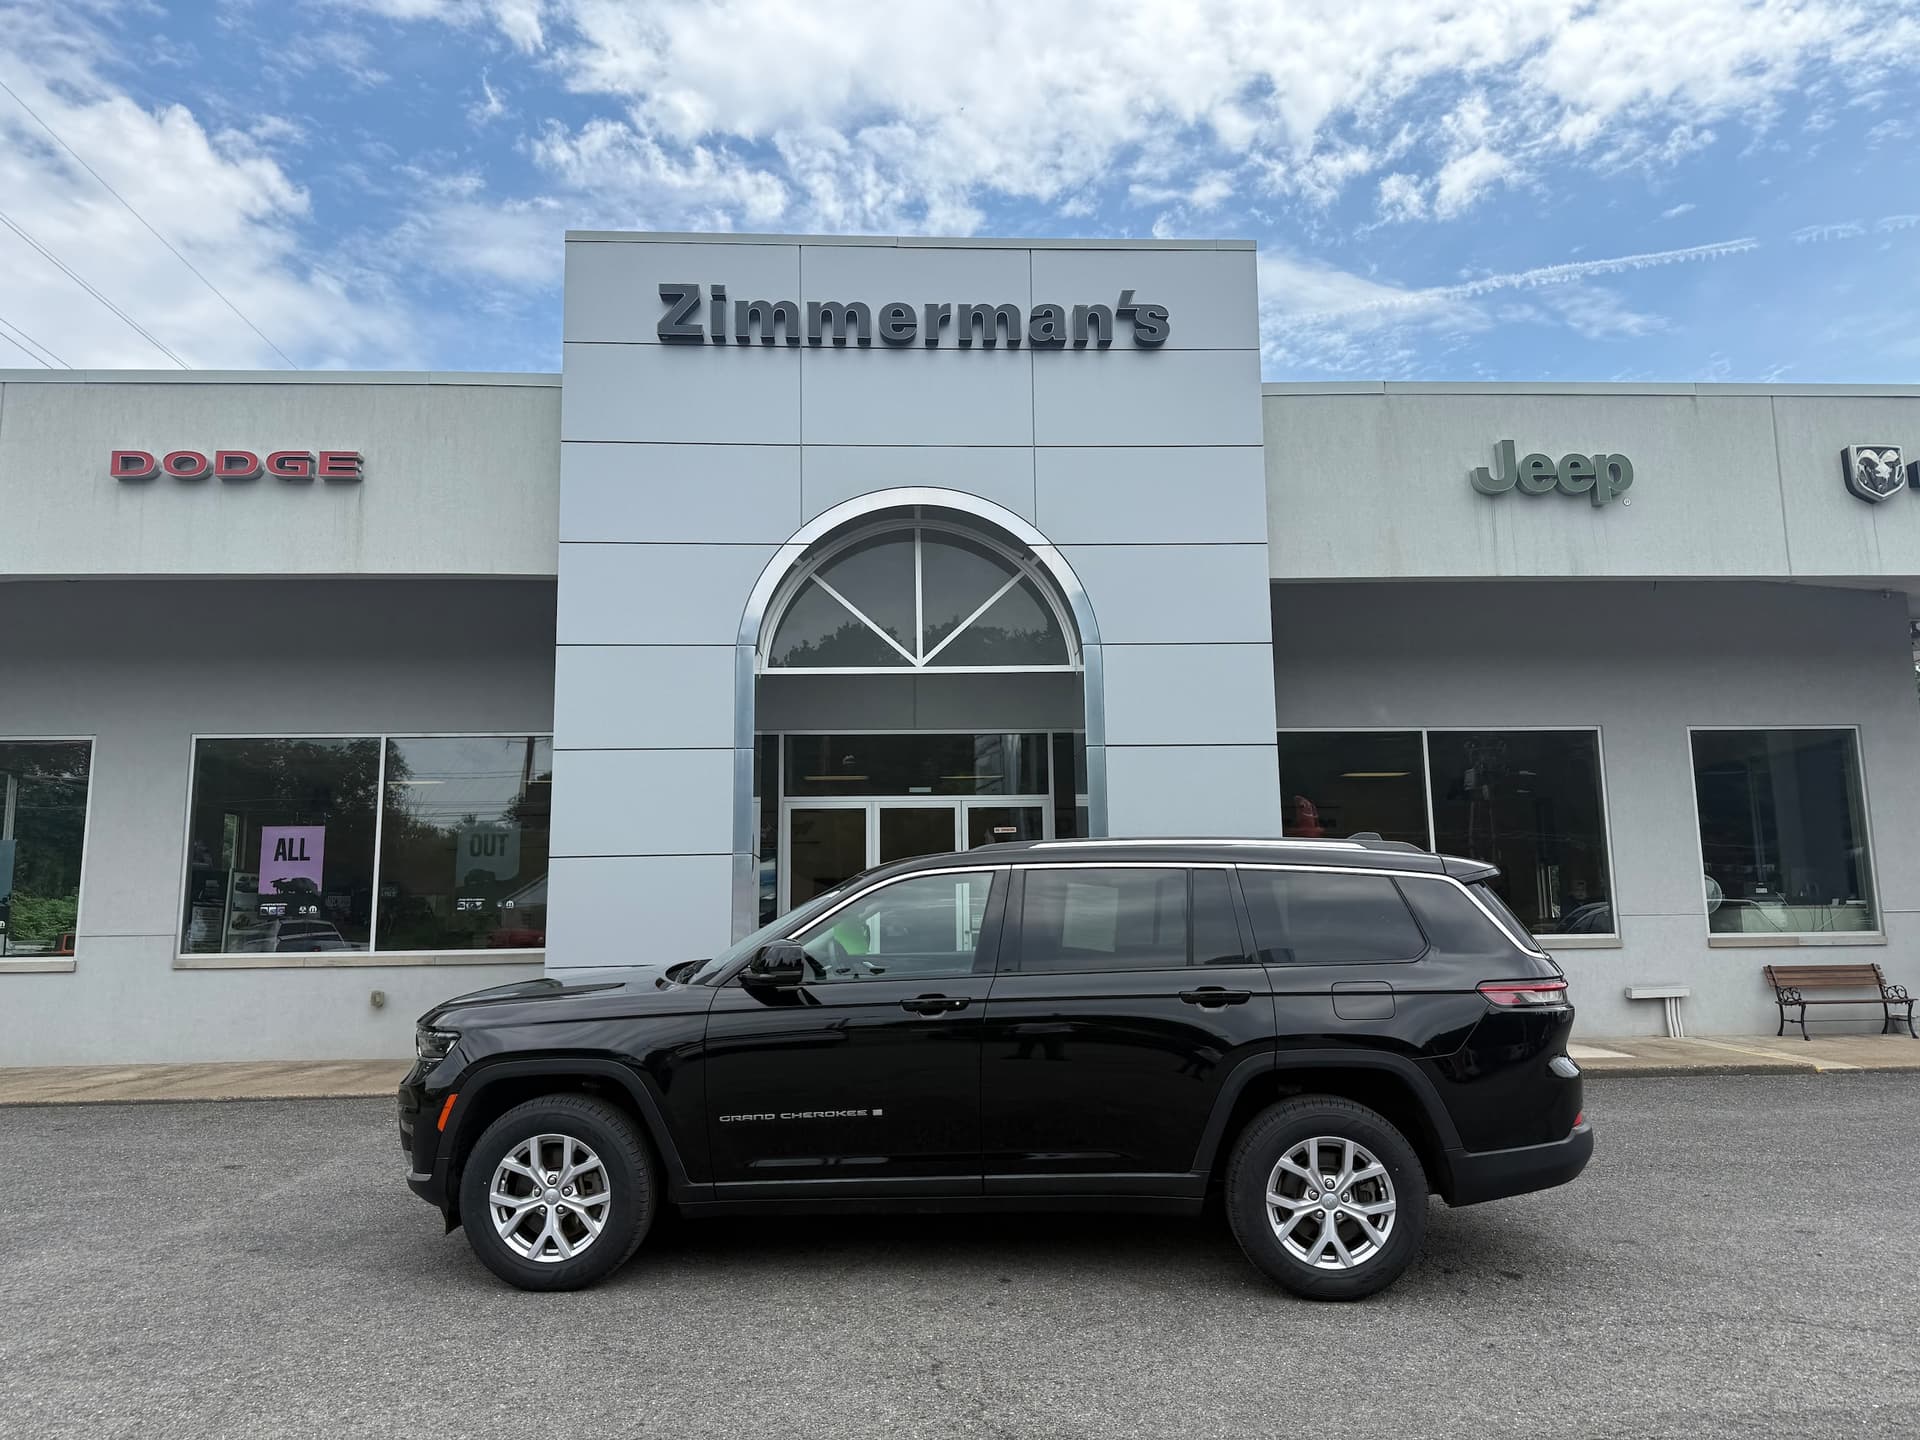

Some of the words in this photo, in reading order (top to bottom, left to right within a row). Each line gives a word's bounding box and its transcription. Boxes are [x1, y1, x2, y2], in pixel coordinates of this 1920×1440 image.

[657, 283, 1172, 350] Zimmerman's
[110, 450, 364, 483] DODGE
[1470, 439, 1634, 509] Jeep
[274, 838, 311, 862] ALL
[469, 833, 510, 857] OUT
[719, 1113, 776, 1123] GRAND
[780, 1109, 868, 1120] CHEROKEE
